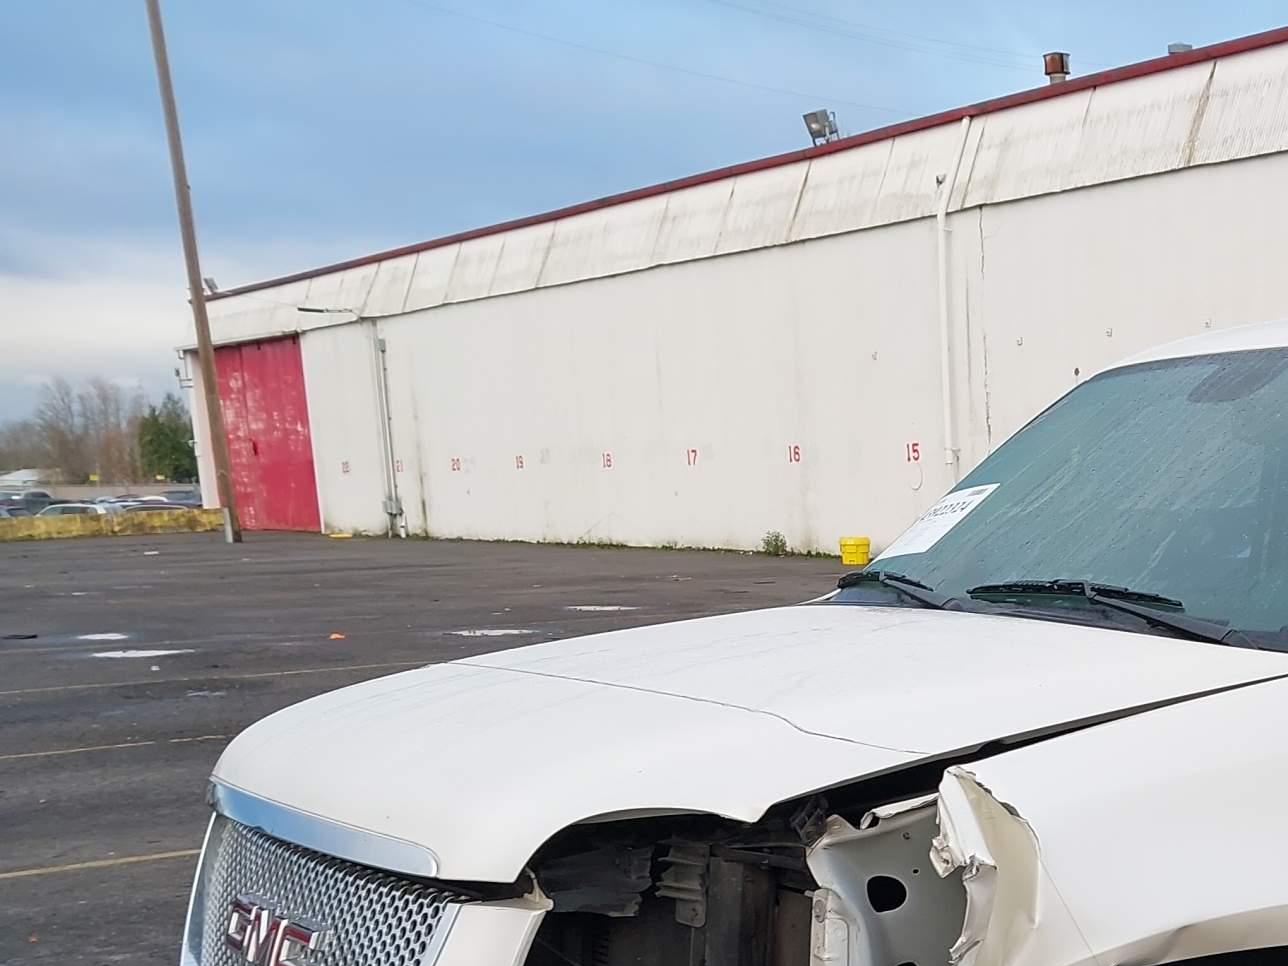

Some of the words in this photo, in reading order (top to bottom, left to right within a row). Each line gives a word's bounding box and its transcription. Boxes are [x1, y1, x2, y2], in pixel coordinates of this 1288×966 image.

[602, 453, 612, 468] 18
[687, 449, 697, 466] 17
[788, 445, 801, 463] 16
[906, 442, 920, 462] 15
